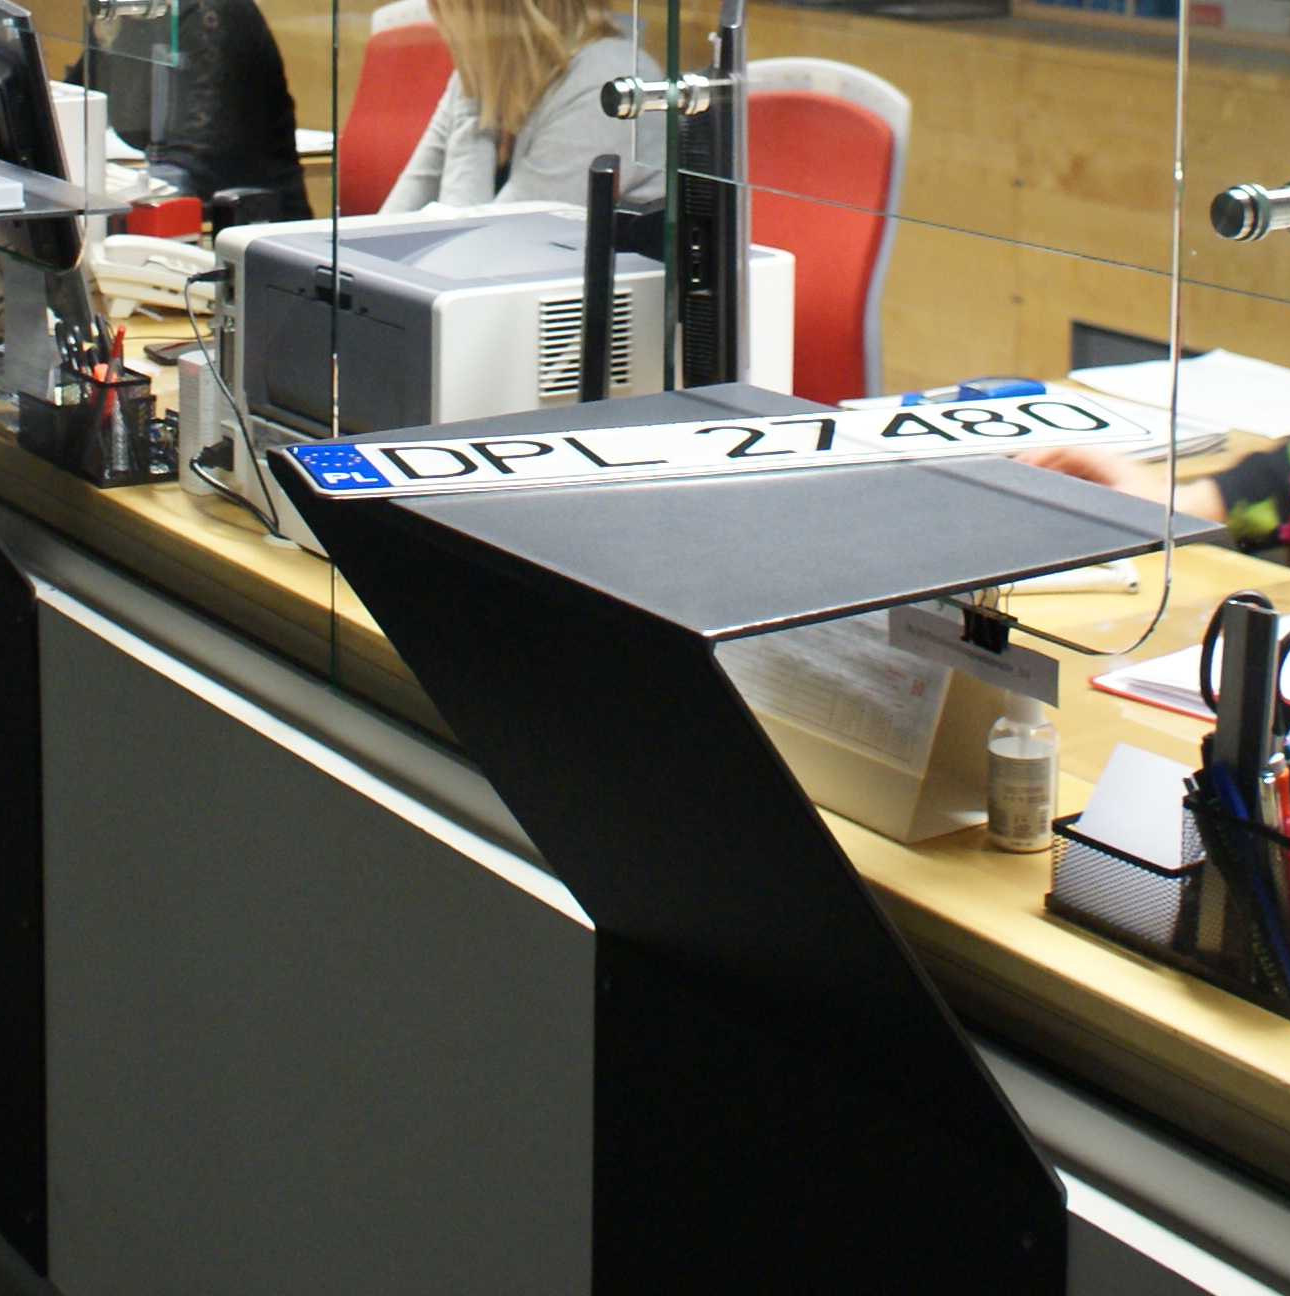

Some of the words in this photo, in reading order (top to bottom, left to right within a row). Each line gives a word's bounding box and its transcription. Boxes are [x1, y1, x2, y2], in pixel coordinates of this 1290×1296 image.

[380, 439, 669, 482] DPL
[697, 400, 1111, 461] 27480
[322, 472, 379, 484] PL
